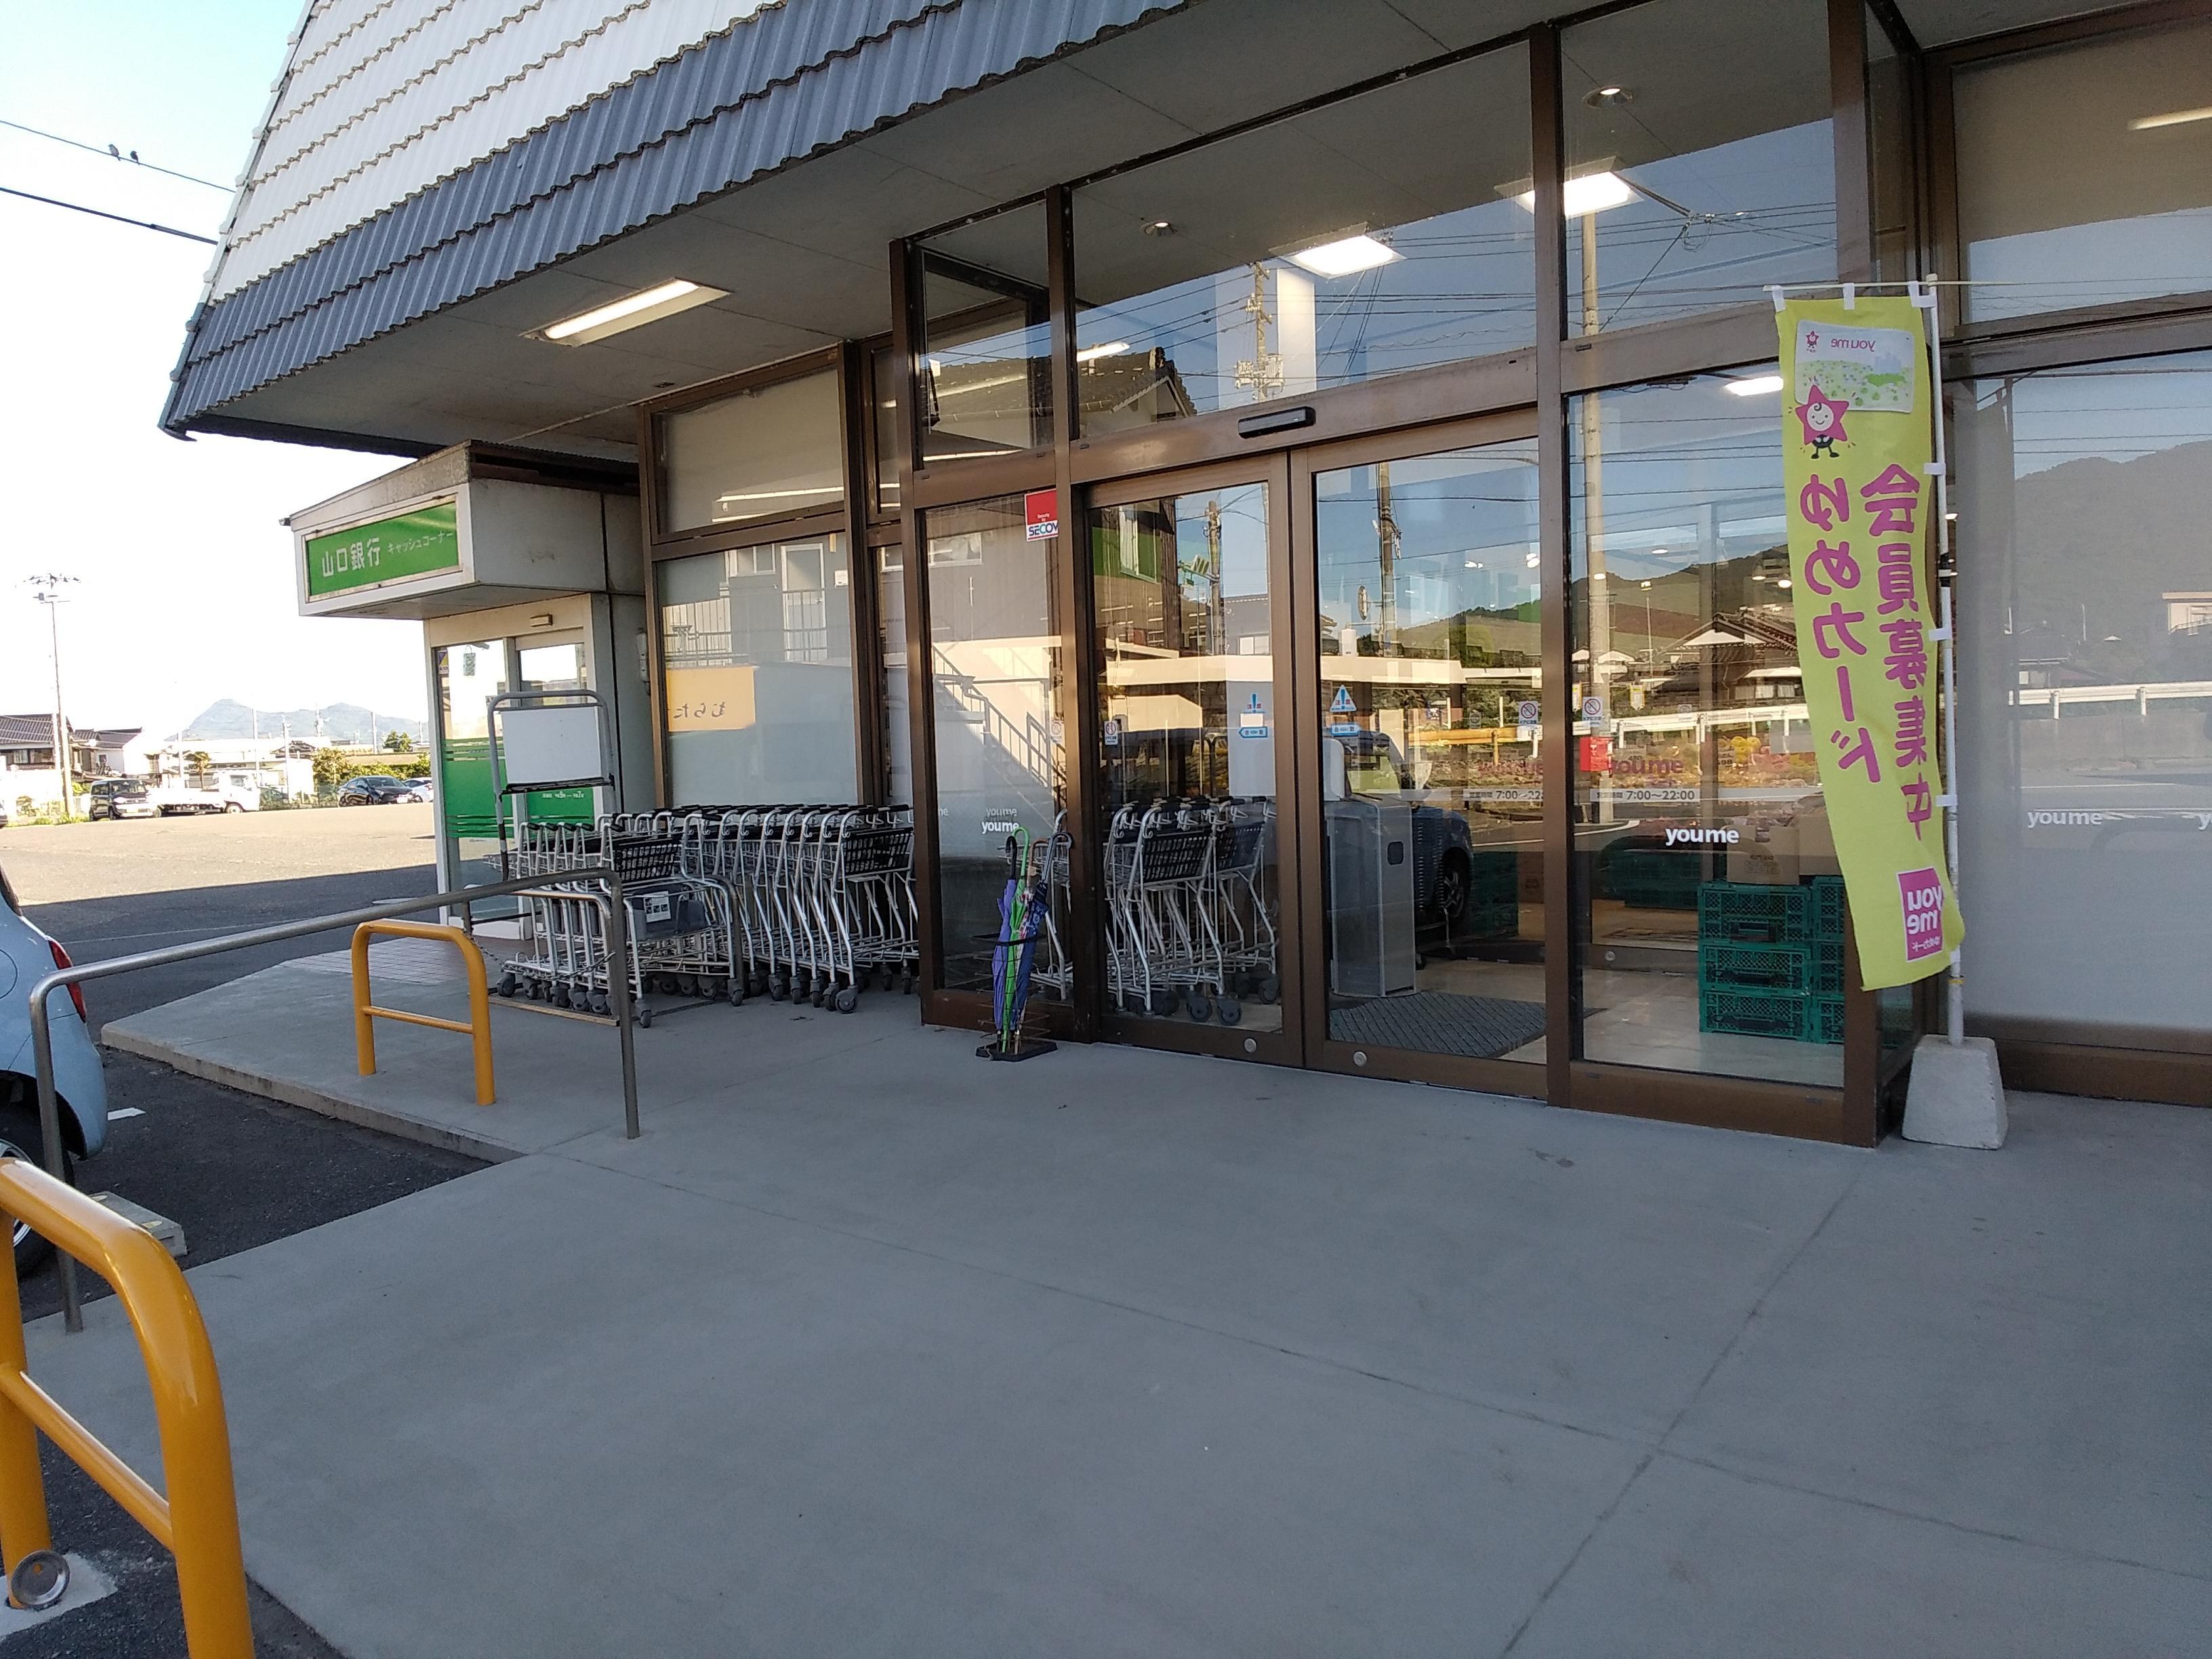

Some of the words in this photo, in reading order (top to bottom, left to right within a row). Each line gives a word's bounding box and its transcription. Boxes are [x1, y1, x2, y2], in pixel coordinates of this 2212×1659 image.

[322, 537, 381, 577] 山口銀行
[388, 531, 453, 555] キャッシュコーナー
[981, 821, 1019, 834] youme
[2027, 812, 2102, 829] youme
[1665, 828, 1740, 846] youme
